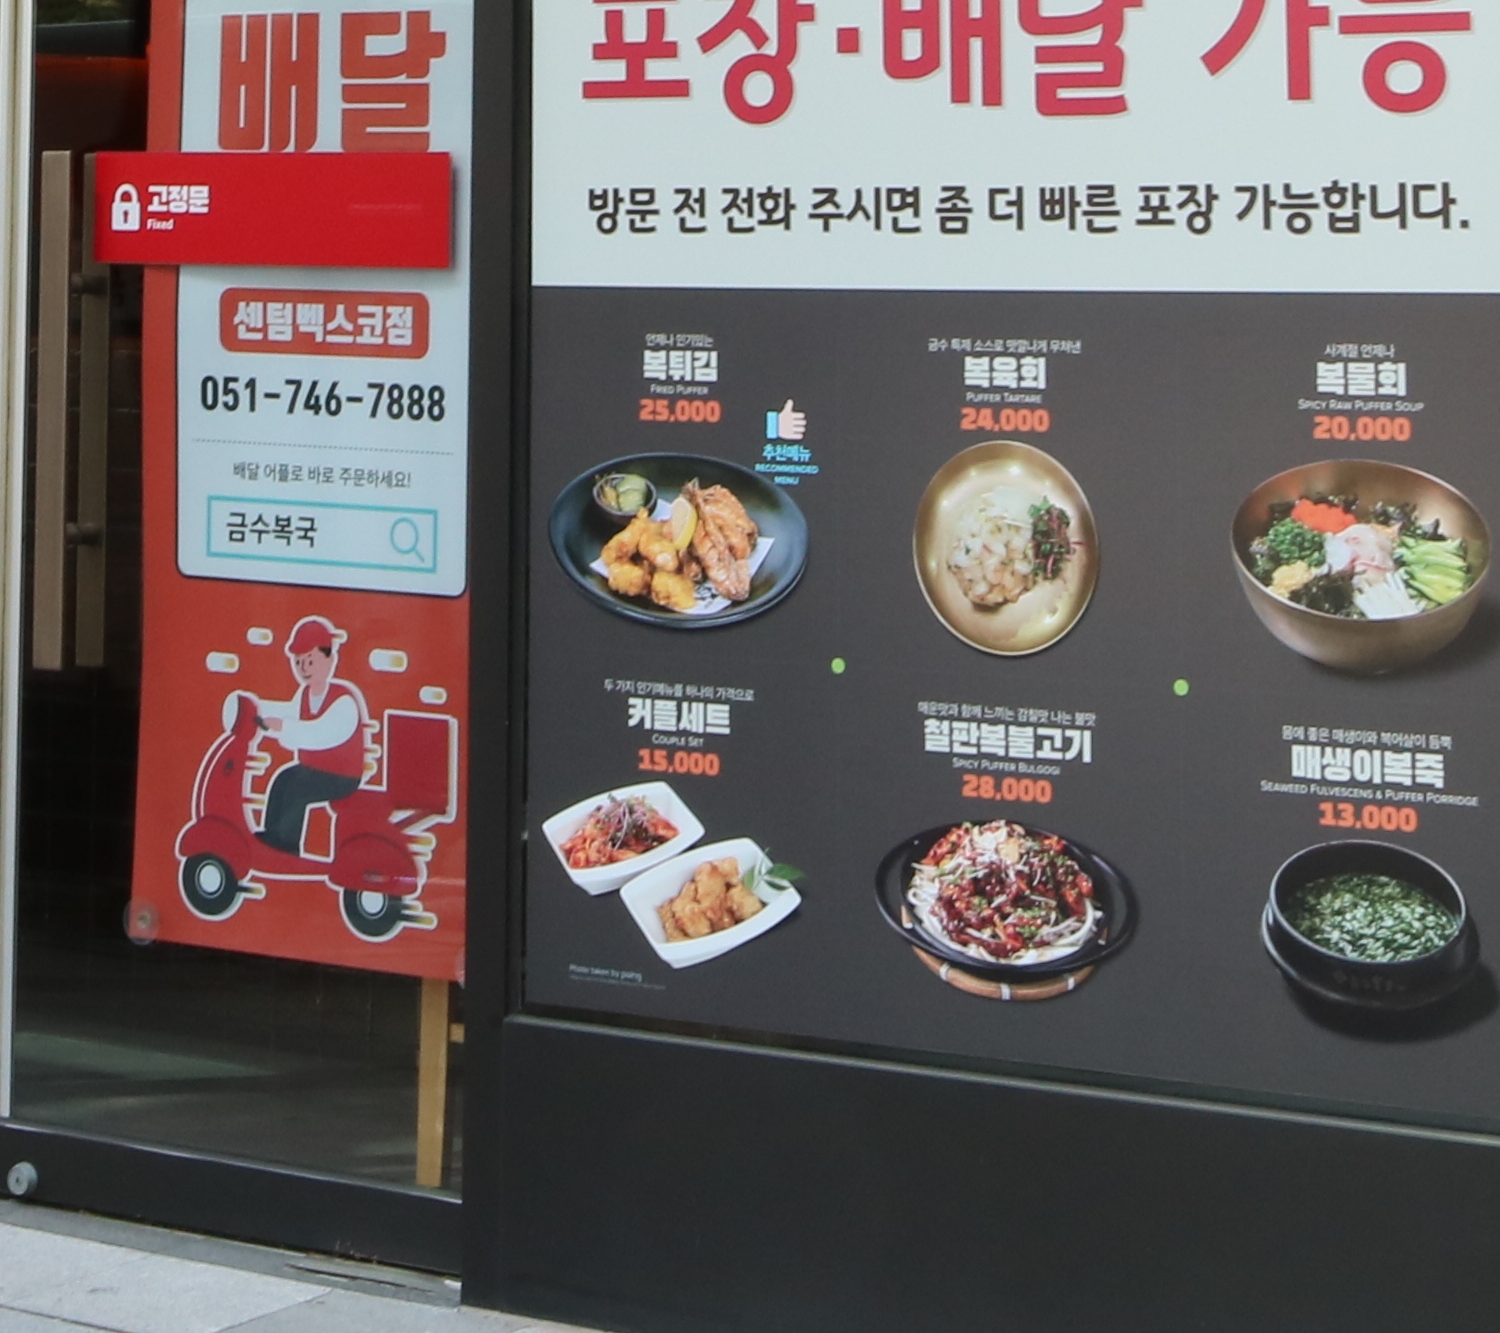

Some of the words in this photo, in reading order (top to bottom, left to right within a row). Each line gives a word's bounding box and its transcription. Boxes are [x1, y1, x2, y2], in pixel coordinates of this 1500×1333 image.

[218, 9, 447, 153] 배달
[147, 185, 211, 215] 고정문
[587, 187, 660, 234] 방문
[672, 186, 708, 233] 전
[720, 185, 797, 234] 전화
[808, 185, 923, 234] 주시면
[935, 185, 974, 233] 좀
[986, 184, 1026, 233] 더
[1037, 184, 1122, 233] 빠른
[1136, 183, 1219, 235] 포장
[1234, 180, 1471, 234] 가능합니다.
[147, 218, 174, 231] Fixed
[232, 301, 414, 347] 센텀벡스코점
[973, 339, 1005, 352] 소스로
[1324, 343, 1359, 359] 사계절
[1360, 343, 1395, 359] 언제나
[643, 349, 719, 383] 복튀김
[963, 355, 1047, 390] 복육회
[1316, 361, 1407, 397] 복물회
[200, 375, 446, 423] 051-746-7888
[639, 398, 722, 424] 25,000
[960, 406, 1051, 433] 24,000
[1313, 414, 1413, 442] 20,000
[232, 462, 260, 484] 배달
[263, 463, 304, 485] 어플로
[307, 464, 335, 486] 바로
[338, 465, 411, 489] 주문하세요!
[226, 512, 318, 548] 금수복국
[628, 696, 731, 735] 커플세트
[924, 718, 1092, 764] 철판복불고기
[638, 748, 722, 777] 15,000
[1290, 744, 1445, 789] 매생이복죽
[961, 773, 1054, 804] 28,000
[1260, 780, 1308, 794] SEAWEED
[1384, 789, 1424, 803] PUFFER
[1426, 791, 1479, 807] PORRIDGE
[1319, 801, 1418, 832] 13,000
